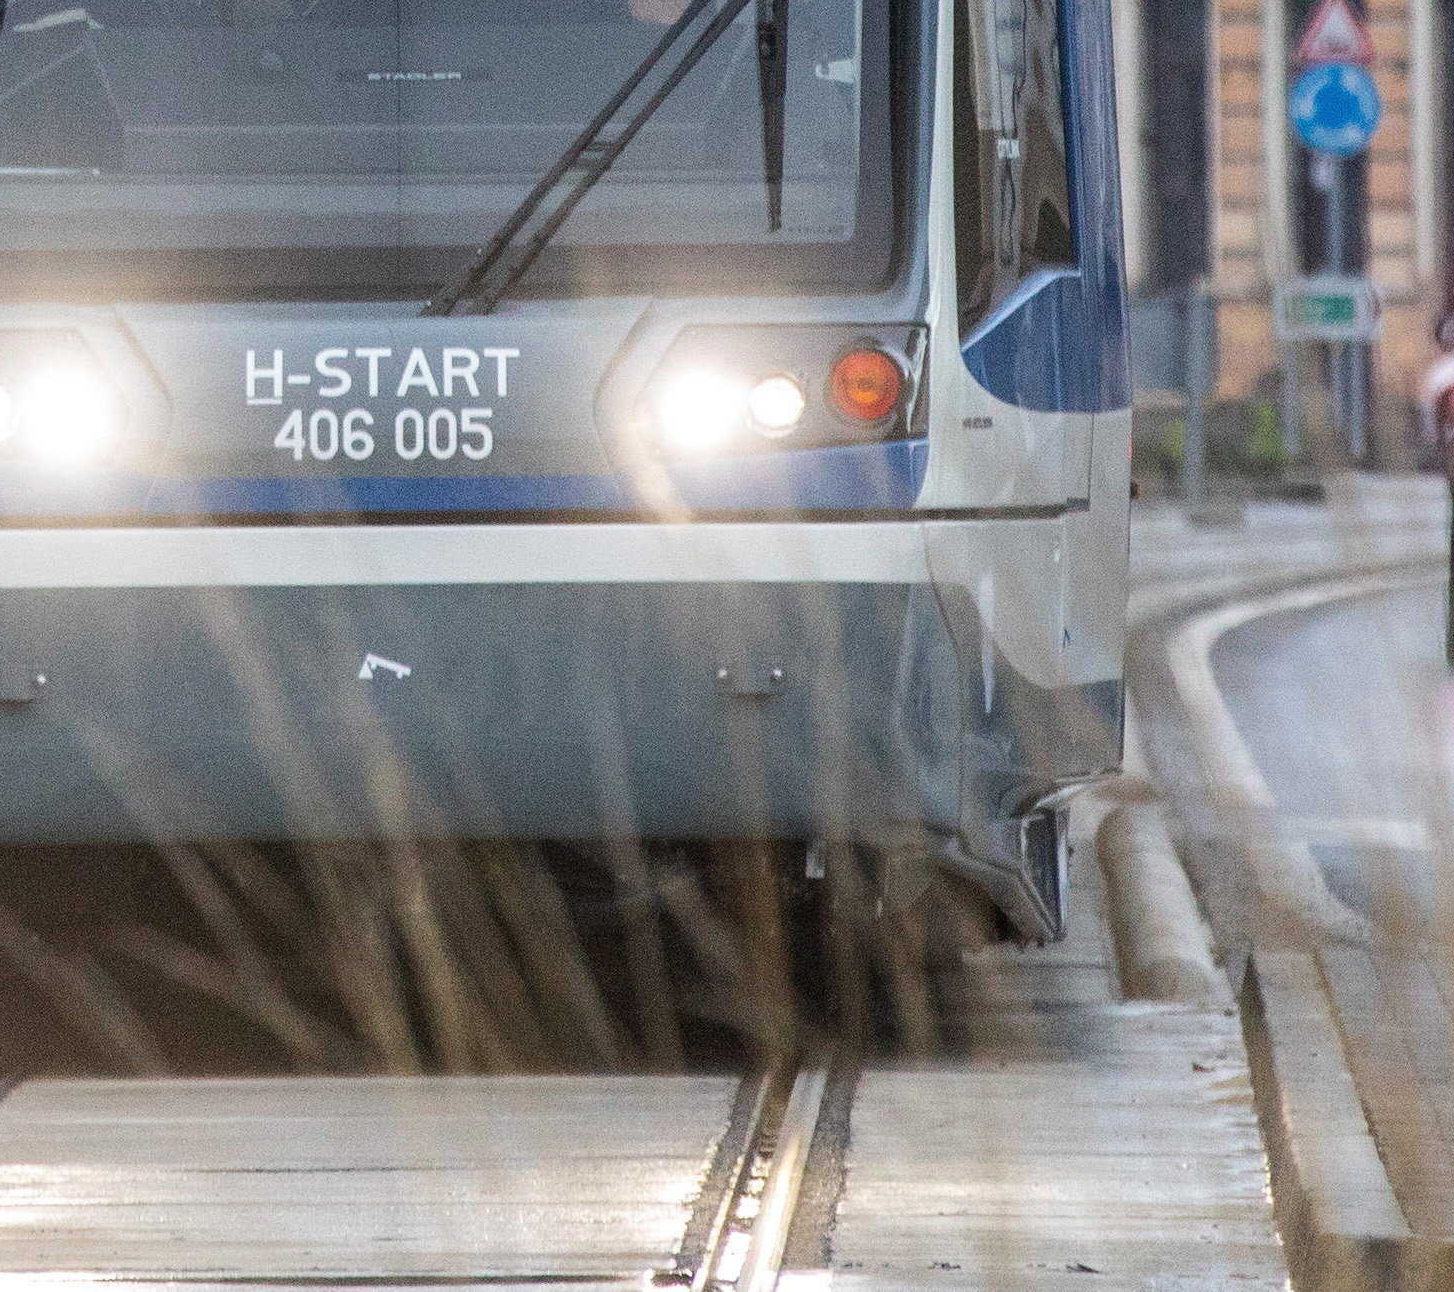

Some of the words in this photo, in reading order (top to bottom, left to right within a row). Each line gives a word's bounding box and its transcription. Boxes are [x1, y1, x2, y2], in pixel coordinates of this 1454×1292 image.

[246, 346, 521, 404] H-START
[273, 407, 376, 461] 406
[394, 406, 494, 461] 005
